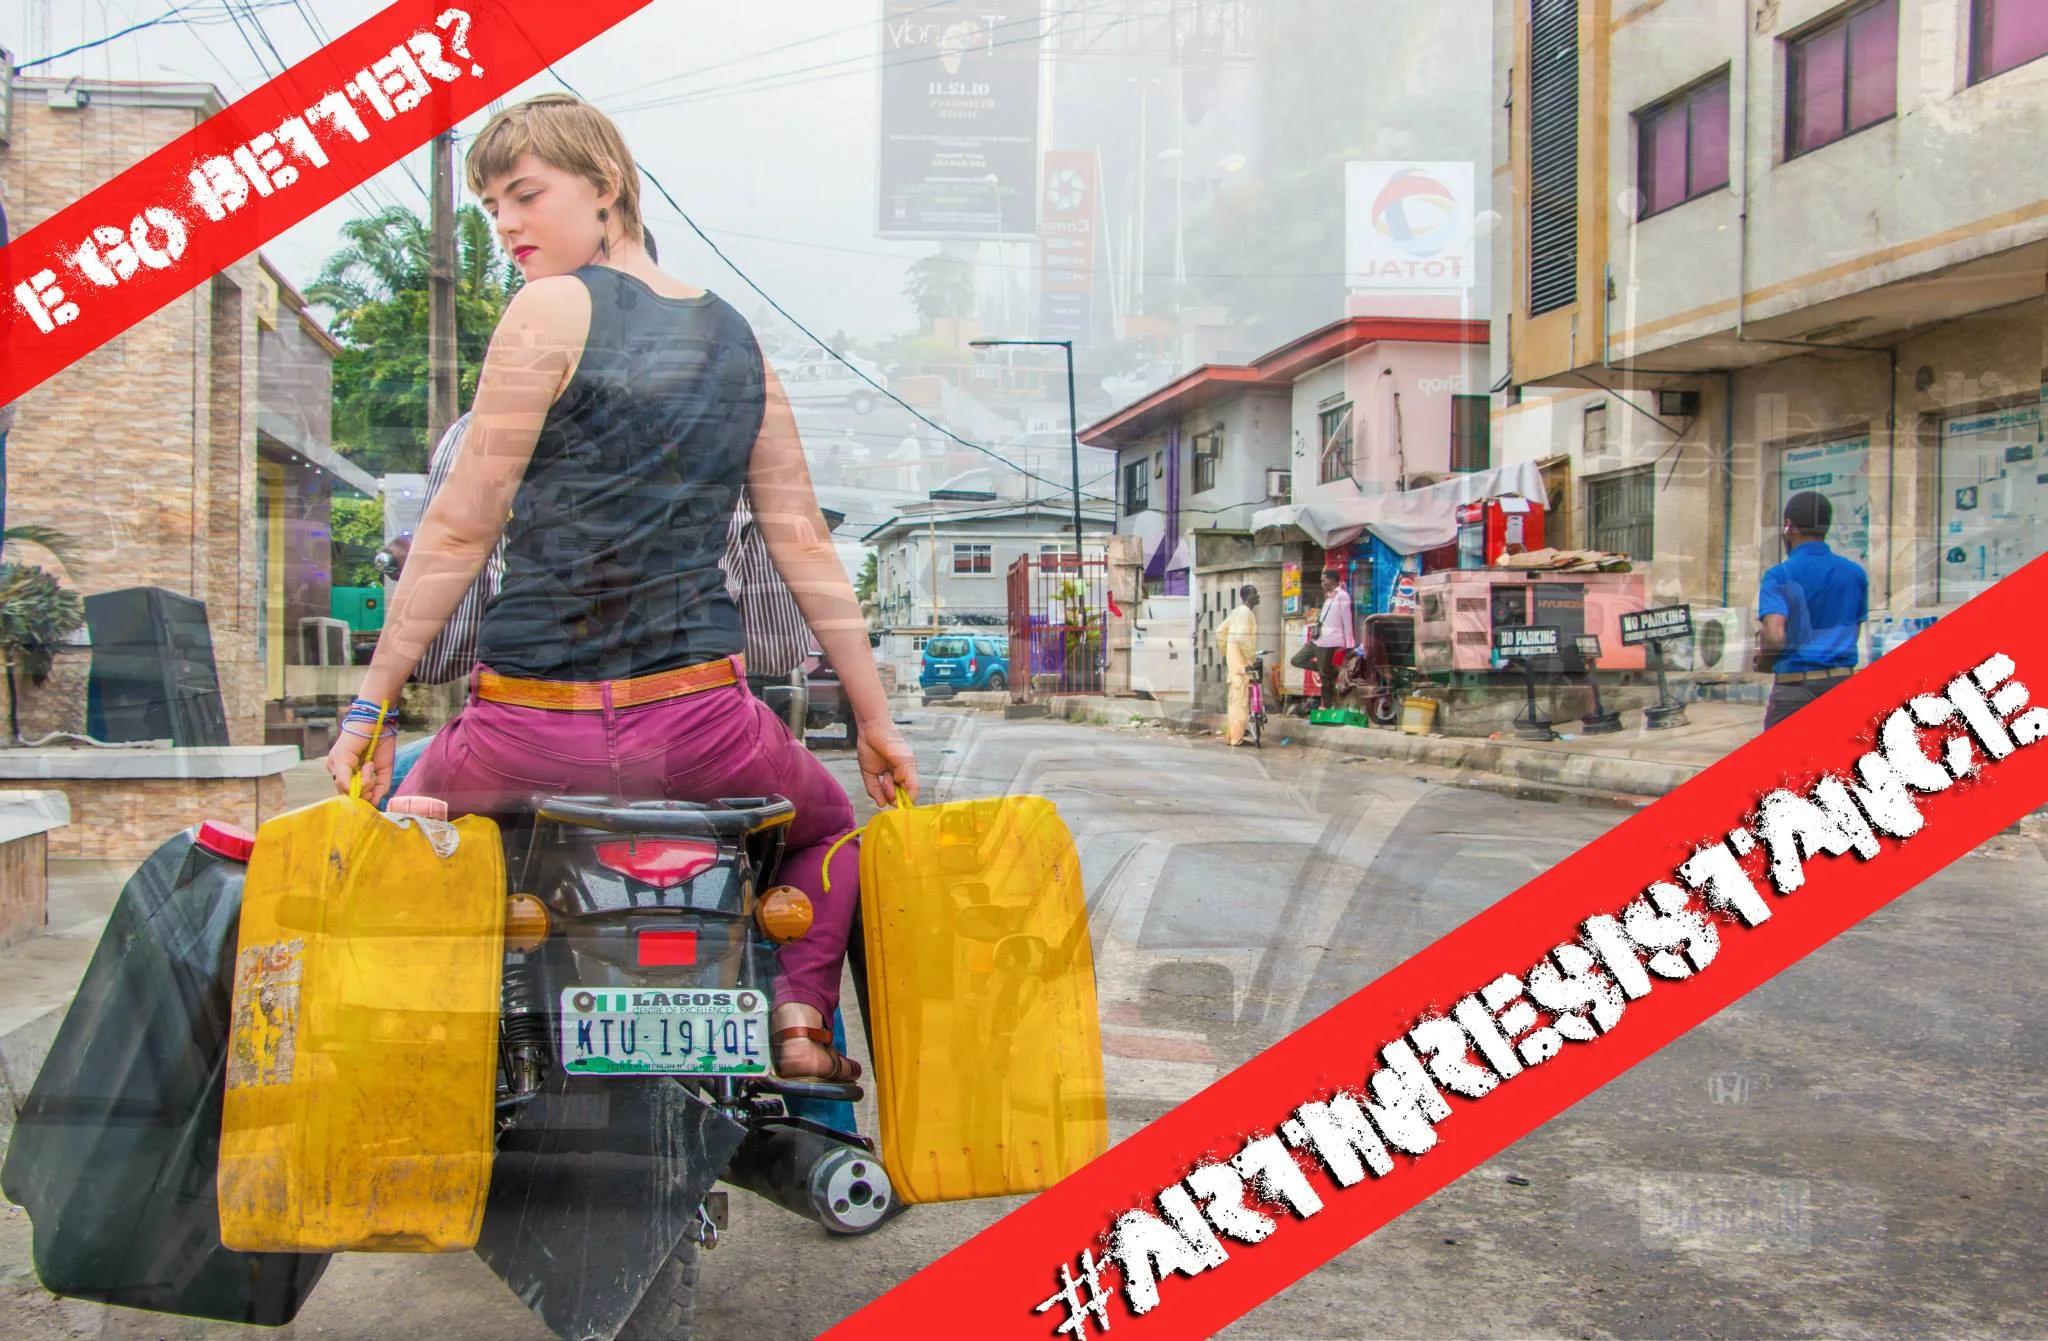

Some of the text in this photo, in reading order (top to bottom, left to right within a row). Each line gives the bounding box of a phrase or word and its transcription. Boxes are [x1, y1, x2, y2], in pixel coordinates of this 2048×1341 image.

[1624, 608, 1687, 632] NO PARKING
[1500, 629, 1556, 646] NO PARKING
[632, 993, 731, 1006] LAGOS
[632, 1005, 731, 1015] CENTRE OF EXCELLENCE
